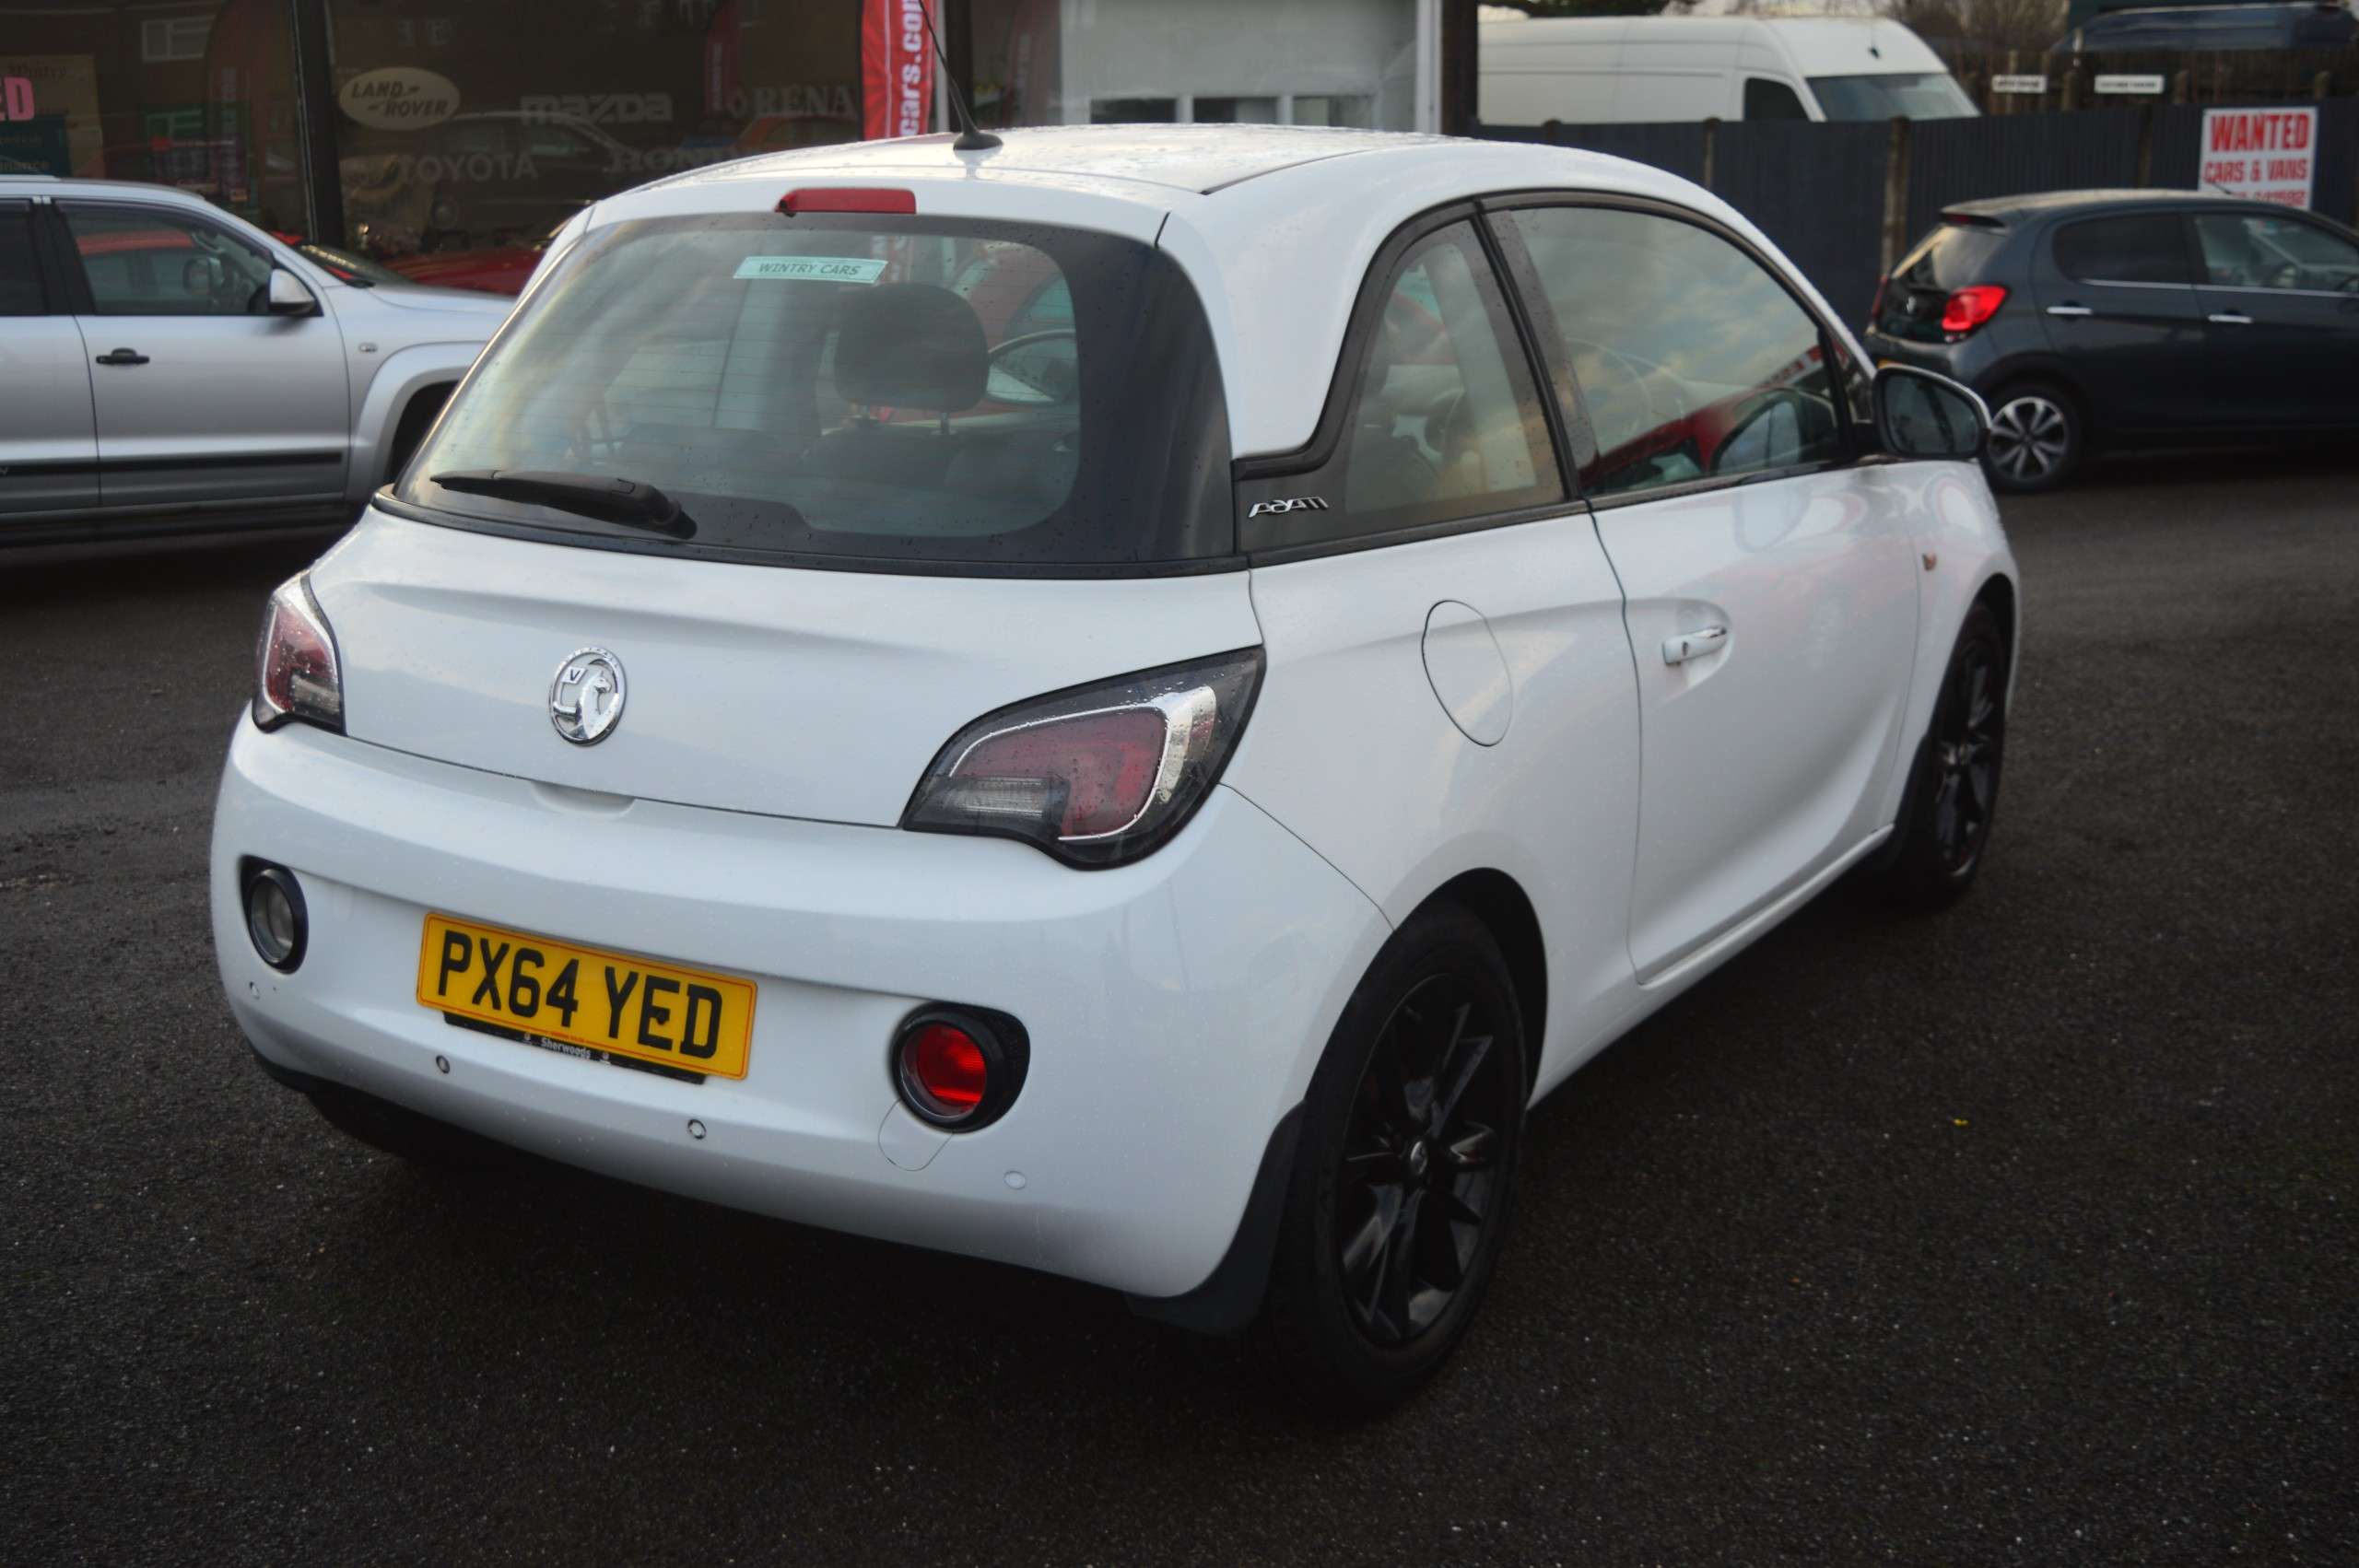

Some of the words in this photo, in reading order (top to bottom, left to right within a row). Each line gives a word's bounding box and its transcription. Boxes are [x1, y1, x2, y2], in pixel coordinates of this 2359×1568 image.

[350, 80, 405, 99] LAND
[383, 99, 450, 118] ROVER
[2211, 113, 2309, 152] WANTED
[399, 153, 539, 181] TOYOTA
[2203, 159, 2246, 185] CARS
[2250, 158, 2261, 182] &
[2267, 158, 2307, 181] VANS
[758, 263, 816, 275] WINTRY
[819, 264, 861, 275] CARS
[438, 930, 580, 1027] PX64
[604, 965, 723, 1059] YED
[541, 1036, 592, 1060] Sherwoods
